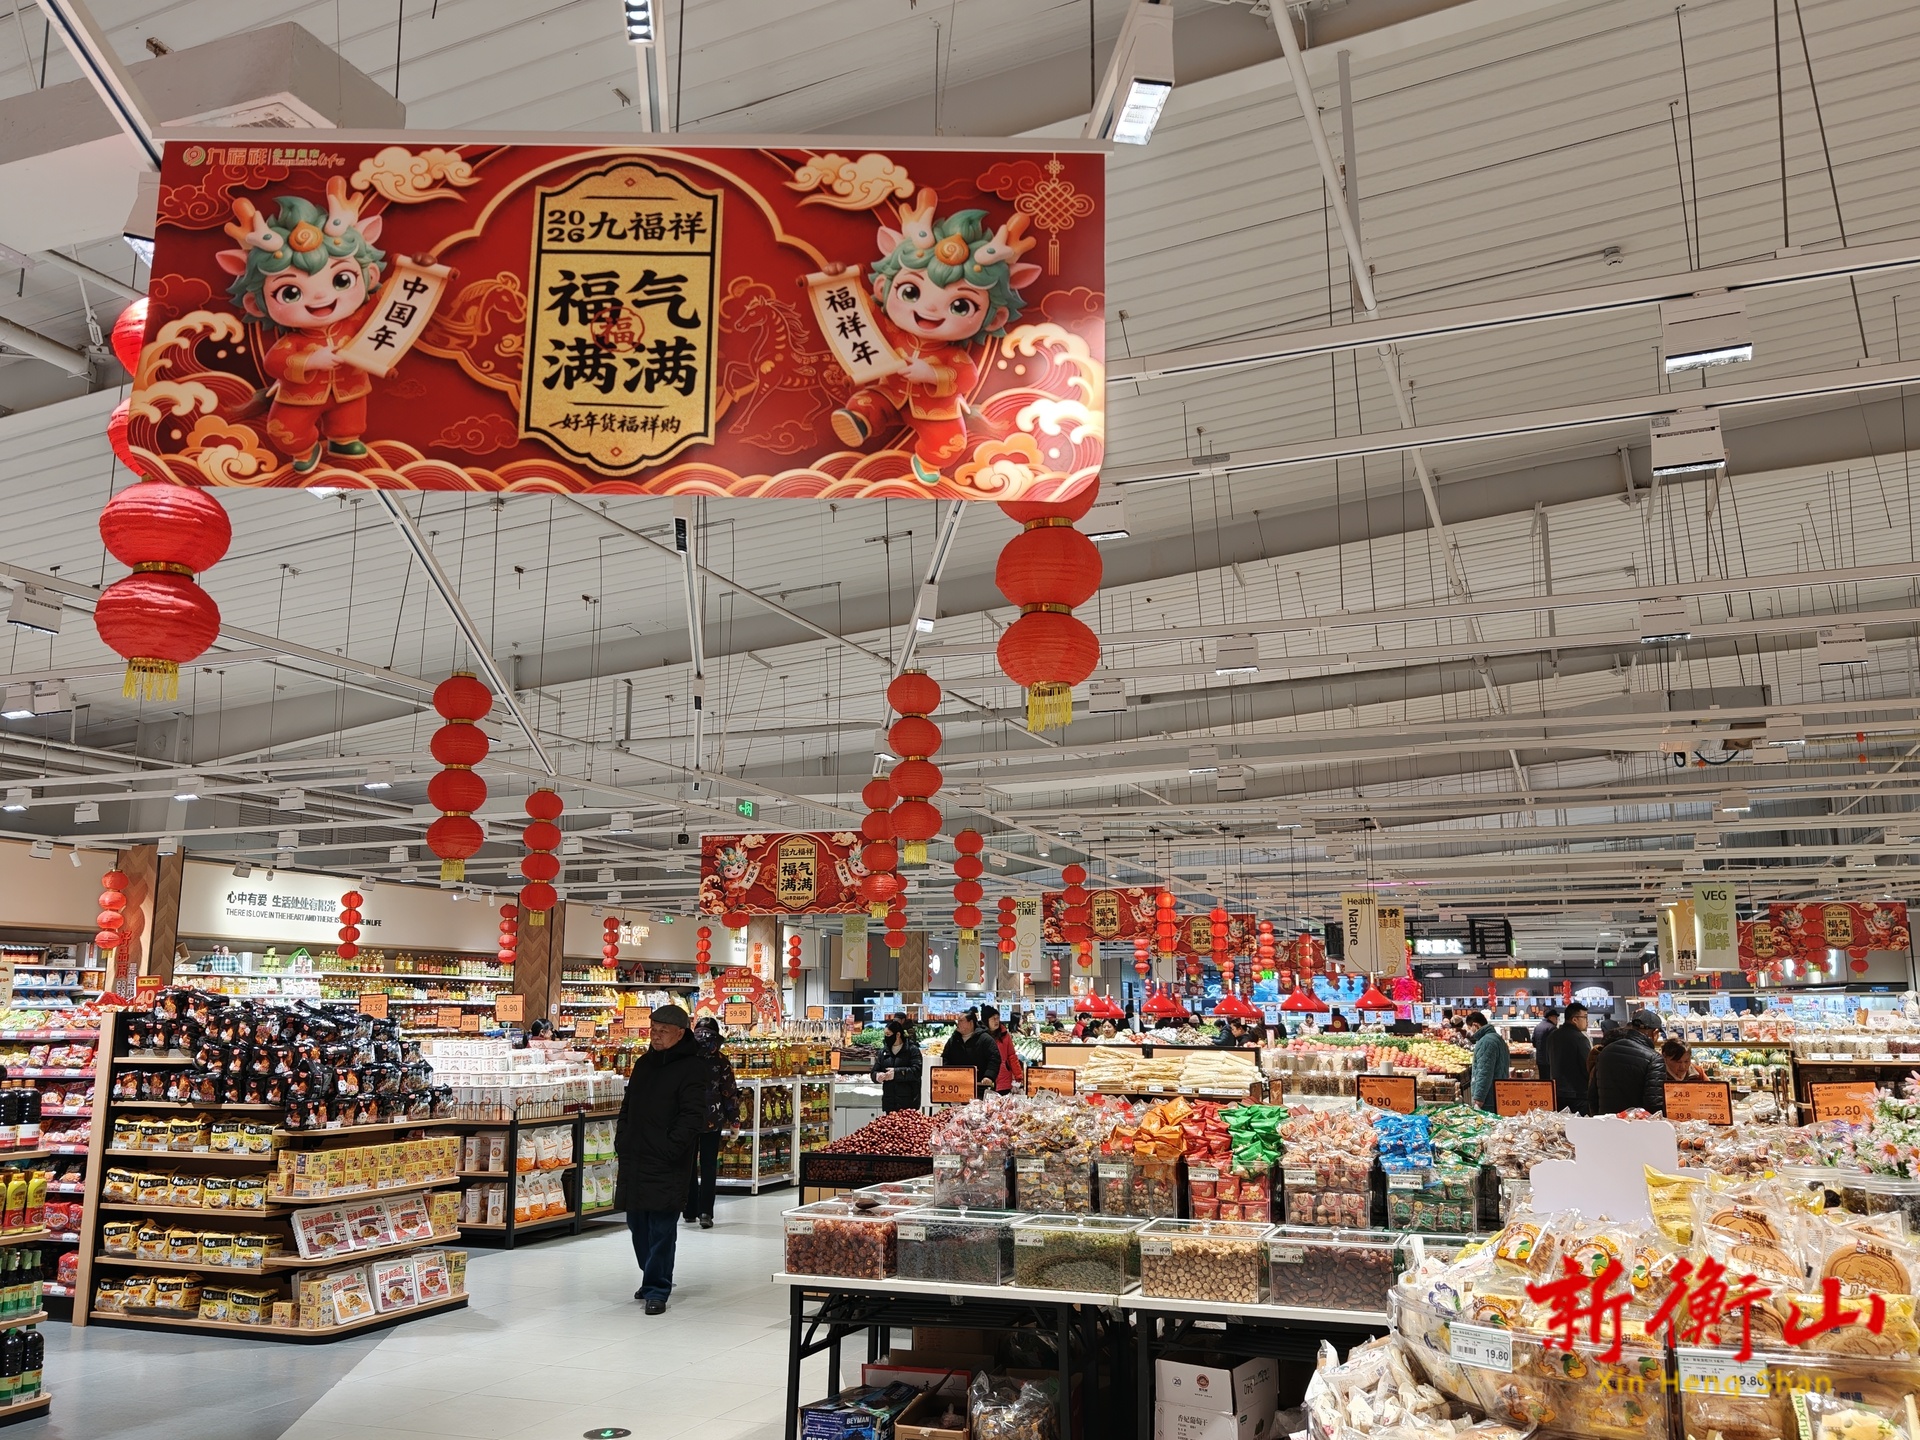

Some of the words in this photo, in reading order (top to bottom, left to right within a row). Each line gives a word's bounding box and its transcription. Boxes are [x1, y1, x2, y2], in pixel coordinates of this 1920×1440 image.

[588, 210, 708, 246] 九福祥
[545, 268, 702, 330] 福气
[367, 275, 430, 354] 中国年
[825, 285, 880, 367] 福祥年
[542, 335, 698, 397] 满满
[789, 847, 815, 857] 九福祥
[781, 861, 814, 877] 福气
[781, 876, 813, 893] 满满
[227, 890, 268, 907] 心中有爱
[272, 894, 337, 913] 生活处处有阳光
[1347, 896, 1374, 906] Health
[1701, 890, 1727, 901] VEG
[226, 907, 246, 917] THERE
[252, 910, 268, 919] LOVE
[275, 912, 286, 920] THE
[286, 912, 305, 921] HEART
[1016, 908, 1037, 916] TIME
[1348, 908, 1359, 946] Nature
[1378, 918, 1401, 929] 健康
[1494, 968, 1527, 979] MEAT
[135, 989, 156, 1005] 40
[364, 1003, 383, 1012] 13.50
[503, 1004, 518, 1012] 9.90
[940, 1084, 959, 1094] 9.90
[1673, 1090, 1690, 1098] 24.8
[1367, 1096, 1391, 1107] 9.90
[1675, 1112, 1692, 1120] 39.8
[1708, 1112, 1725, 1120] 29.8
[1825, 1104, 1861, 1117] 12.80
[1486, 1348, 1509, 1361] 19.80
[1732, 1375, 1765, 1387] 19.80
